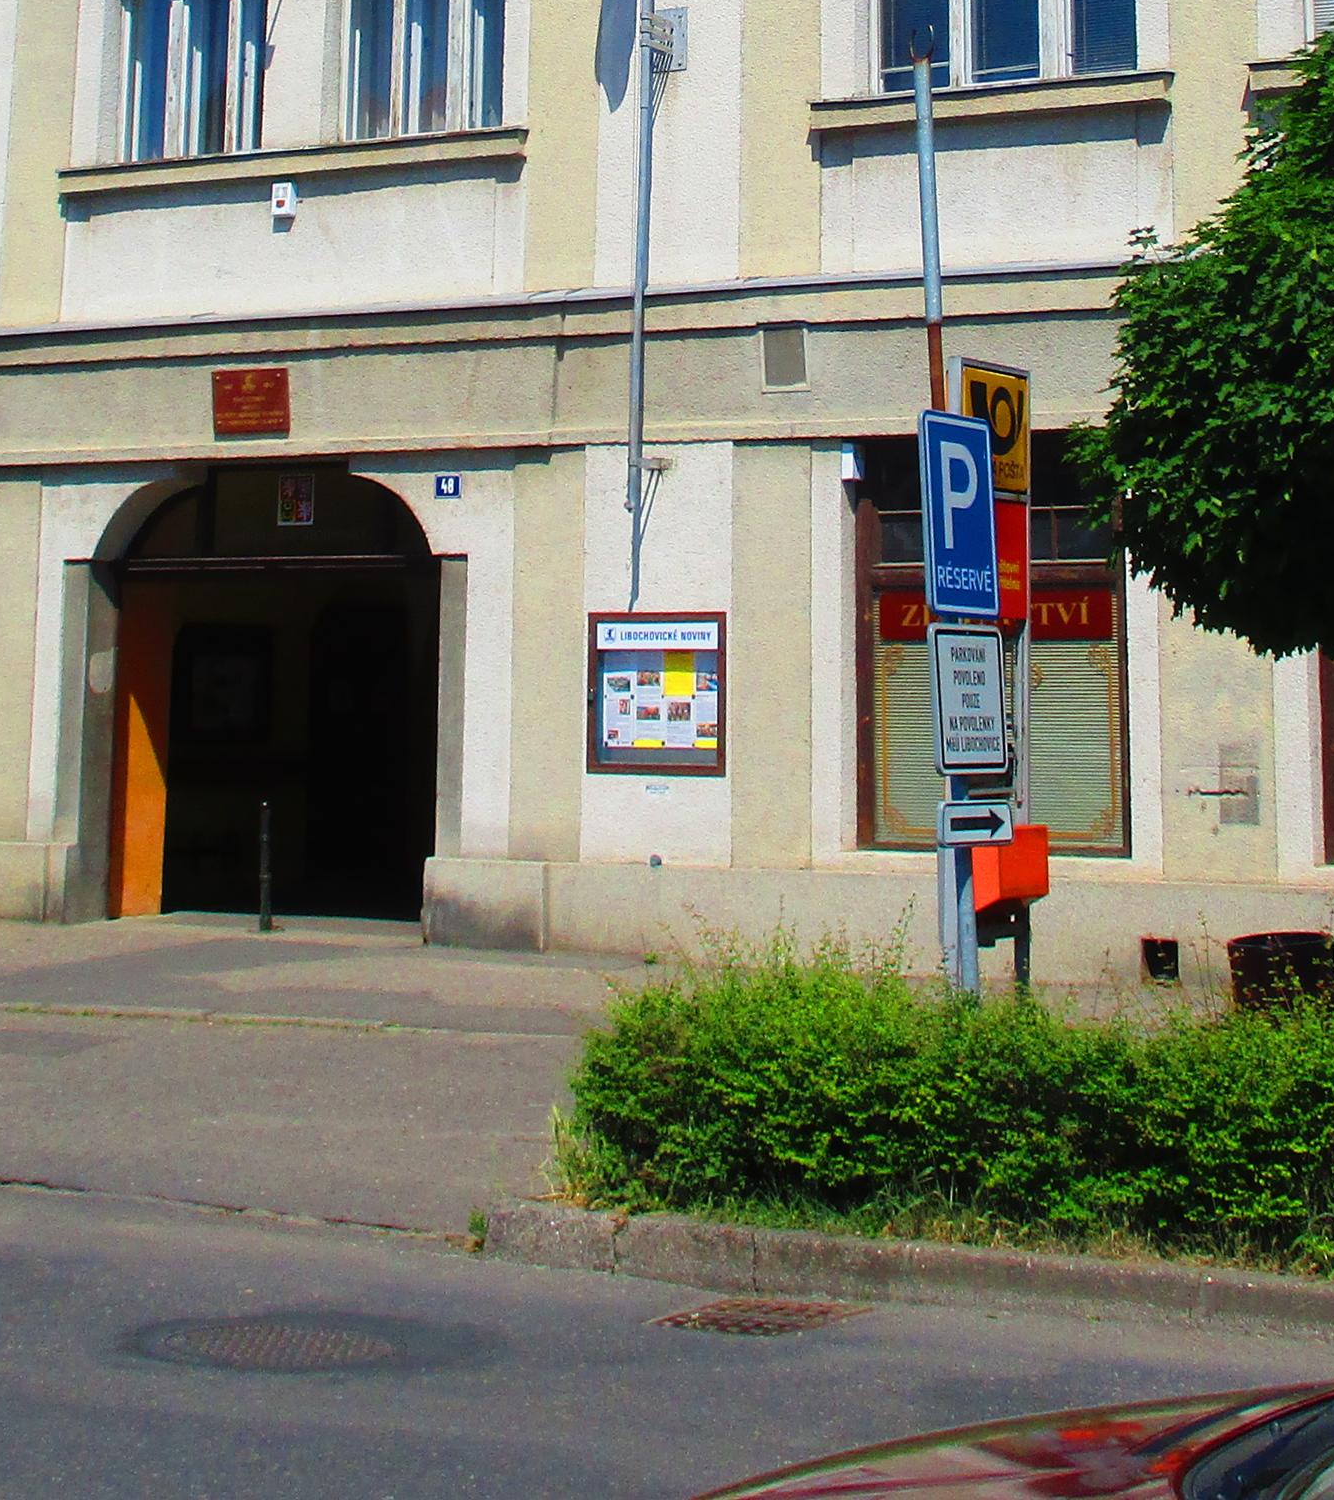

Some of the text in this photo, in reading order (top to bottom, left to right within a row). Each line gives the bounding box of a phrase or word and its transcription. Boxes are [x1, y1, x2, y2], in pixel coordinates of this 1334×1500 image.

[998, 462, 1025, 481] POŠTA
[441, 478, 454, 494] 48
[940, 441, 978, 549] P
[938, 560, 992, 593] RÉSERVÉ
[620, 628, 711, 641] LIBOCHOVICKÉ NOVINY
[953, 670, 986, 685] POVOLENO
[962, 693, 981, 708] POUZE
[949, 716, 995, 732] NA POVOLENKY
